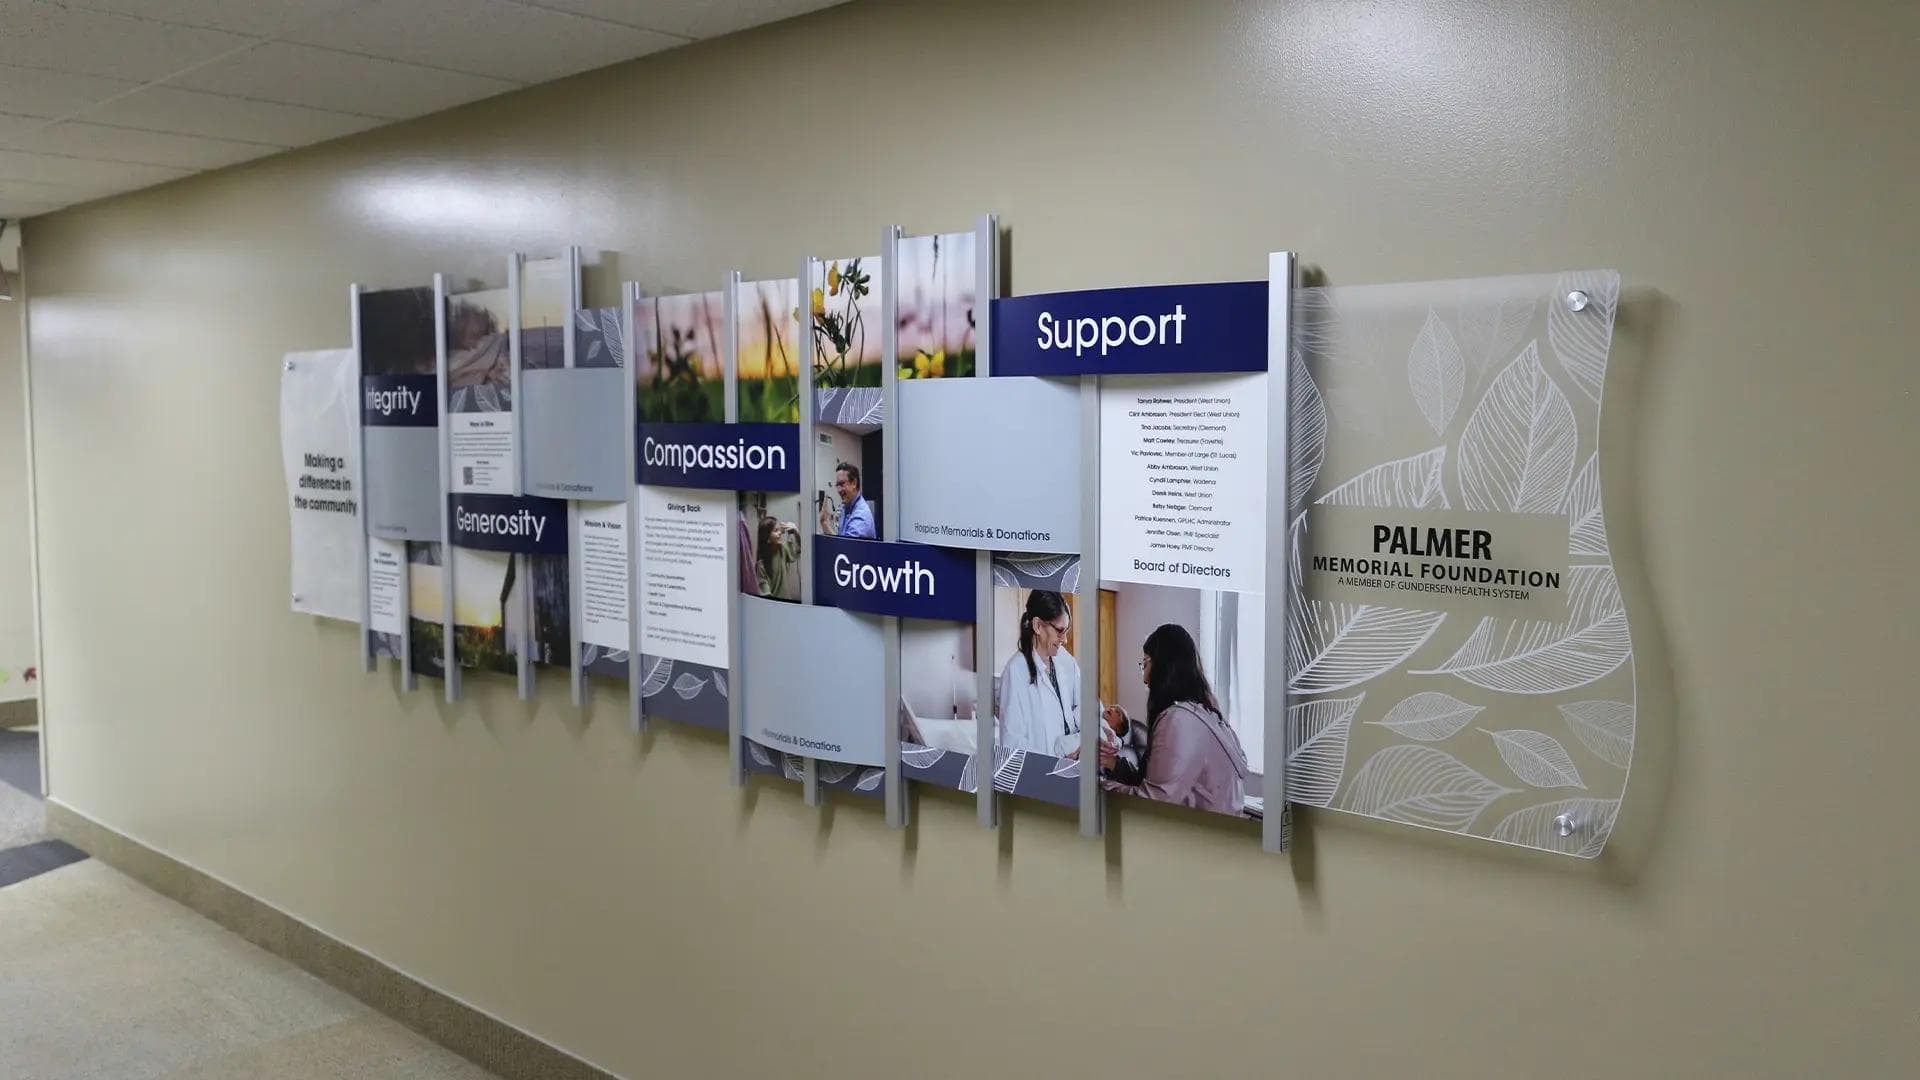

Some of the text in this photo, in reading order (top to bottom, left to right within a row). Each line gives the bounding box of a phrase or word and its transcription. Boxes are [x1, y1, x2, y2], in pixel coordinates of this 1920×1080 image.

[1037, 304, 1187, 357] Support
[366, 385, 421, 416] Integrity
[1223, 411, 1240, 419] Union)
[1173, 424, 1197, 432] Secretary
[304, 453, 344, 472] Making a
[644, 436, 786, 474] Compassion
[1195, 452, 1209, 460] Large
[1147, 463, 1160, 471] Abby
[299, 474, 351, 491] difference in
[294, 493, 357, 517] the community
[667, 502, 701, 513] Giving Back
[456, 505, 546, 542] Generosity
[914, 522, 1051, 541] Hospice Memorials & Donations
[1197, 518, 1231, 526] Administrator
[1195, 532, 1219, 540] Specialist
[1373, 525, 1492, 561] PALMER
[834, 553, 935, 596] Growth
[1134, 559, 1231, 577] Board of Directors
[1312, 556, 1560, 589] MEMORIAL FOUNDATION
[1338, 577, 1530, 601] A MEMBER OF GUNDERSEN HEALTH SYSTEM
[792, 735, 798, 745] &
[800, 737, 842, 753] Donations
